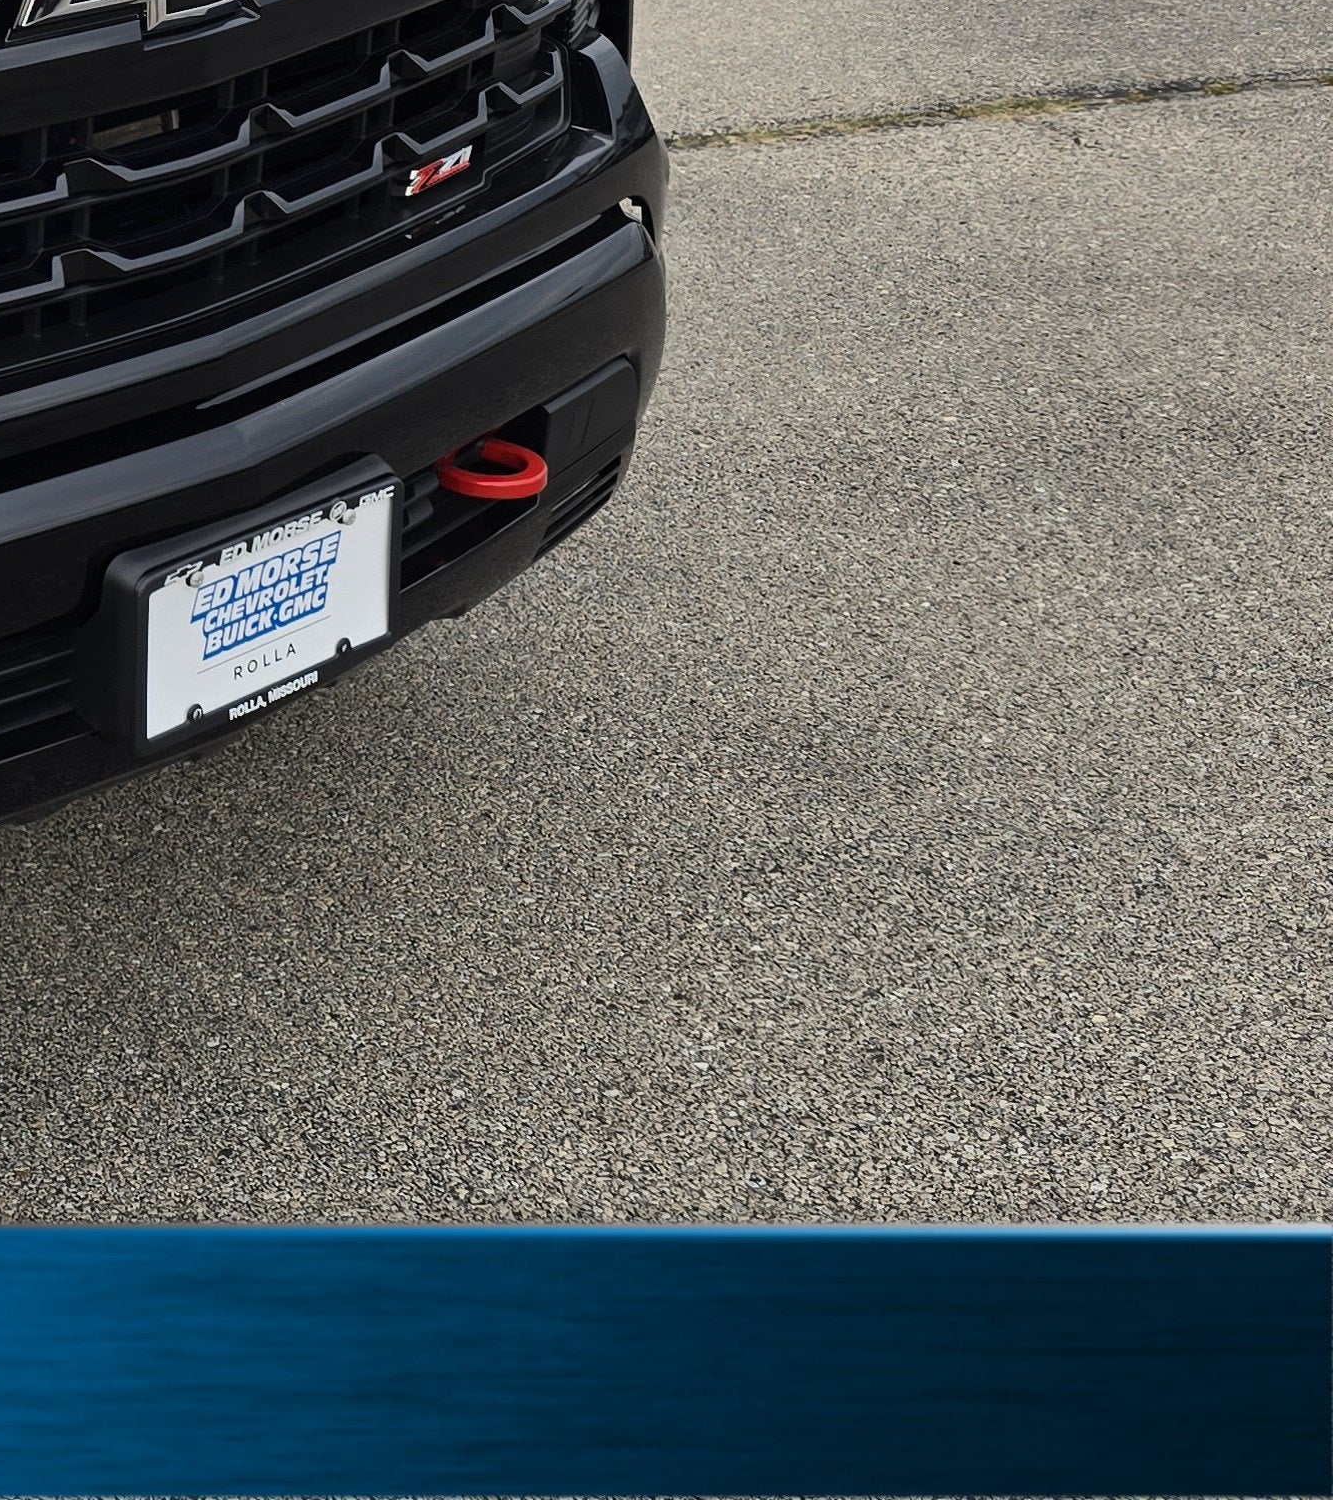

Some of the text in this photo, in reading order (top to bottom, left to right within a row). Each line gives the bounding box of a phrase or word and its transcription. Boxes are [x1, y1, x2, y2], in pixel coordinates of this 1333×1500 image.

[219, 485, 395, 567] ED MORSE GMC
[191, 532, 340, 618] ED MORSE
[203, 564, 329, 634] CHEVROLET
[228, 670, 319, 721] ROLLA, MISSOURI
[234, 642, 296, 680] ROLLA
